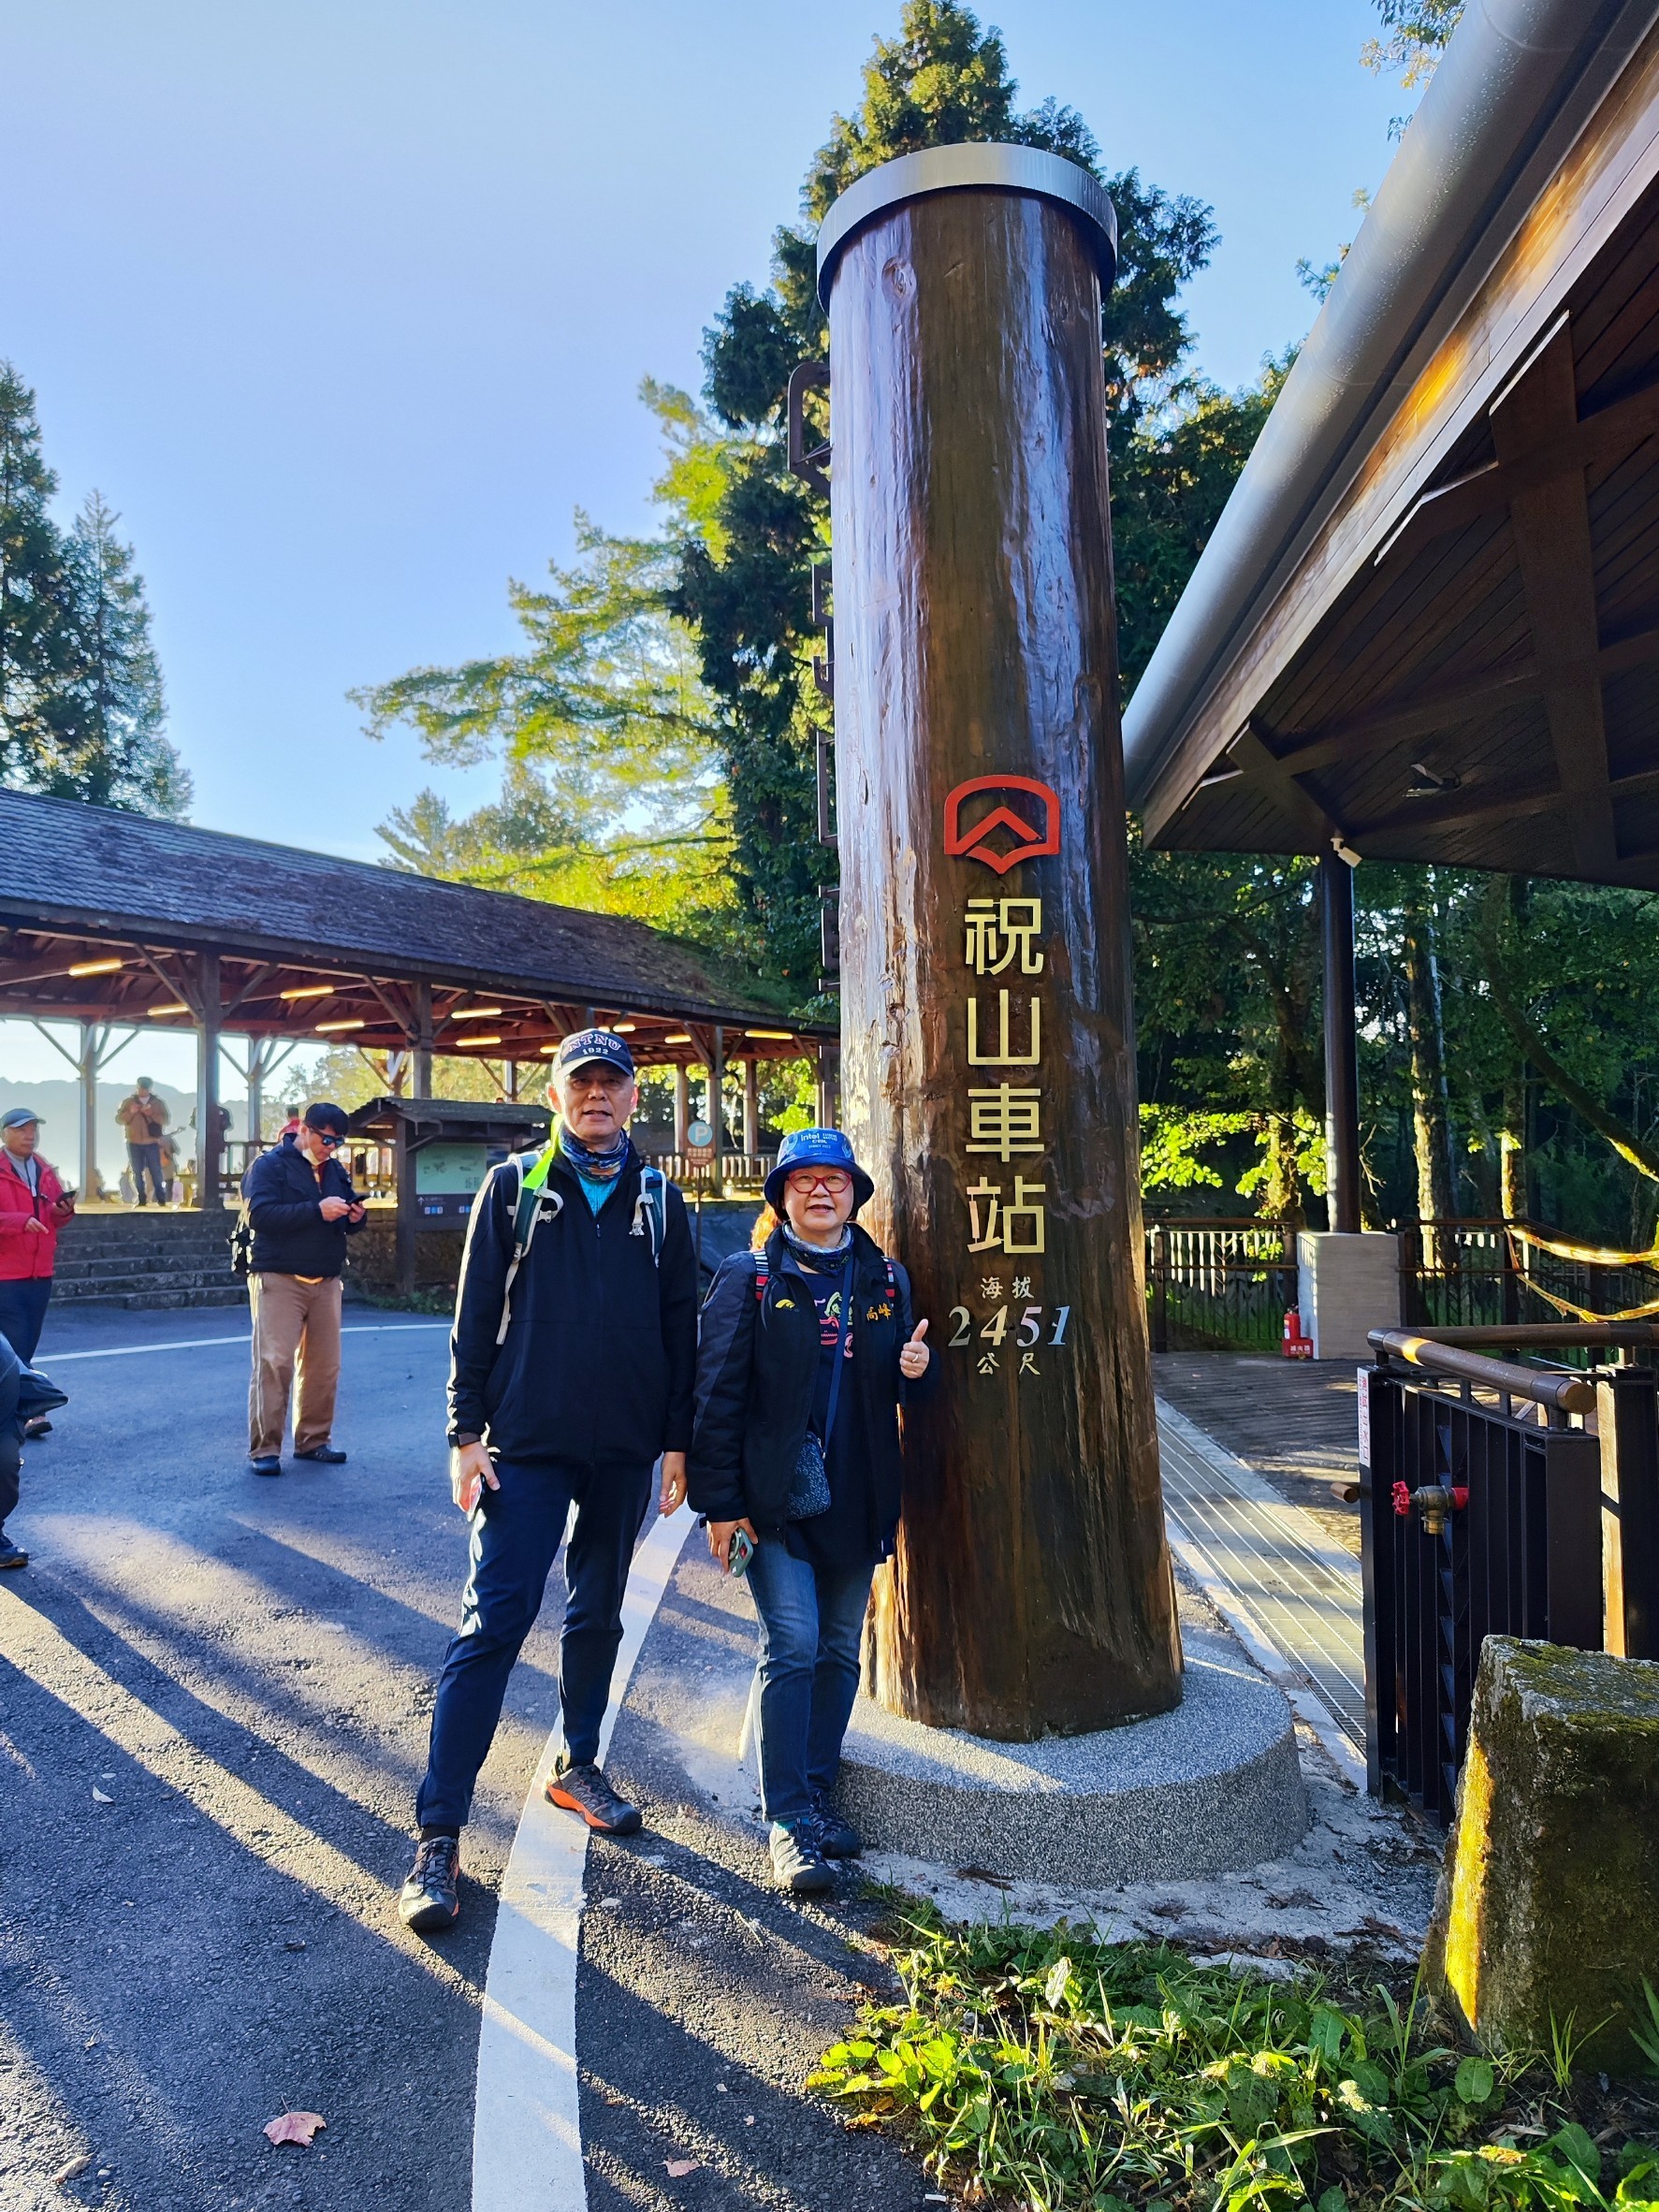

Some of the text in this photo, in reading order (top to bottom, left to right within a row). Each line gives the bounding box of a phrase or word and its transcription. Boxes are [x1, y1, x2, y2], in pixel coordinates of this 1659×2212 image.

[568, 1033, 621, 1052] NTNU
[582, 1047, 609, 1055] 1922
[965, 897, 1046, 1254] 祝山車站
[695, 1126, 708, 1142] P
[800, 1132, 821, 1142] intel
[980, 1275, 1034, 1299] 海拔
[947, 1304, 1070, 1347] 2451
[976, 1352, 1041, 1375] 公尺
